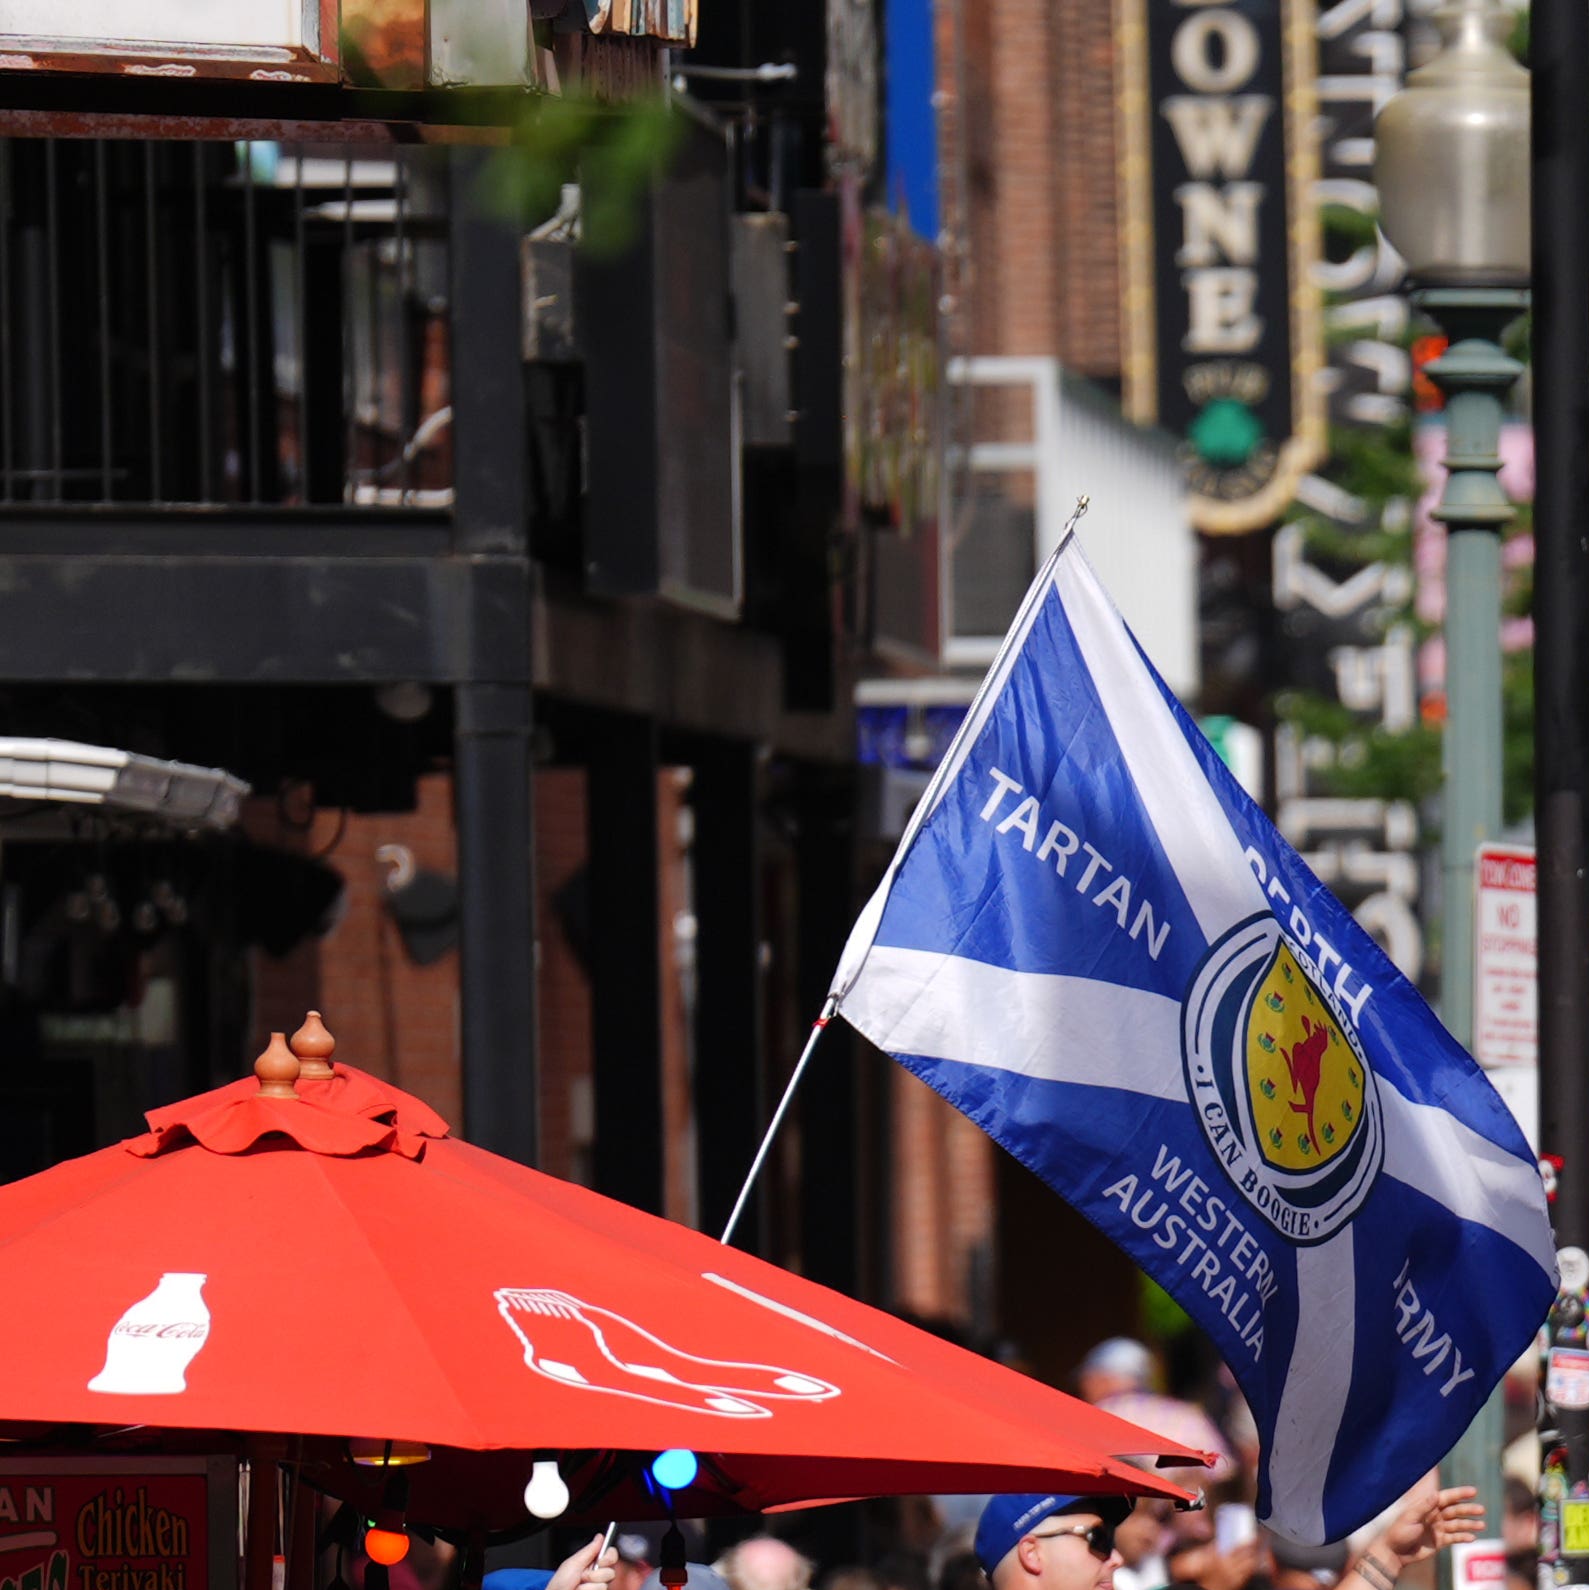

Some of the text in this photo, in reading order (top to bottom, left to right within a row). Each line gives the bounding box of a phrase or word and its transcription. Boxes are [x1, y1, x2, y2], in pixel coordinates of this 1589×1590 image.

[979, 766, 1172, 961] TARTAN
[1150, 1143, 1279, 1301] WESTERN
[1204, 1099, 1244, 1169] CAN
[1238, 1166, 1311, 1237] BOOGIE
[1102, 1174, 1266, 1363] AUSTRALIA
[77, 1486, 188, 1557] Chicken
